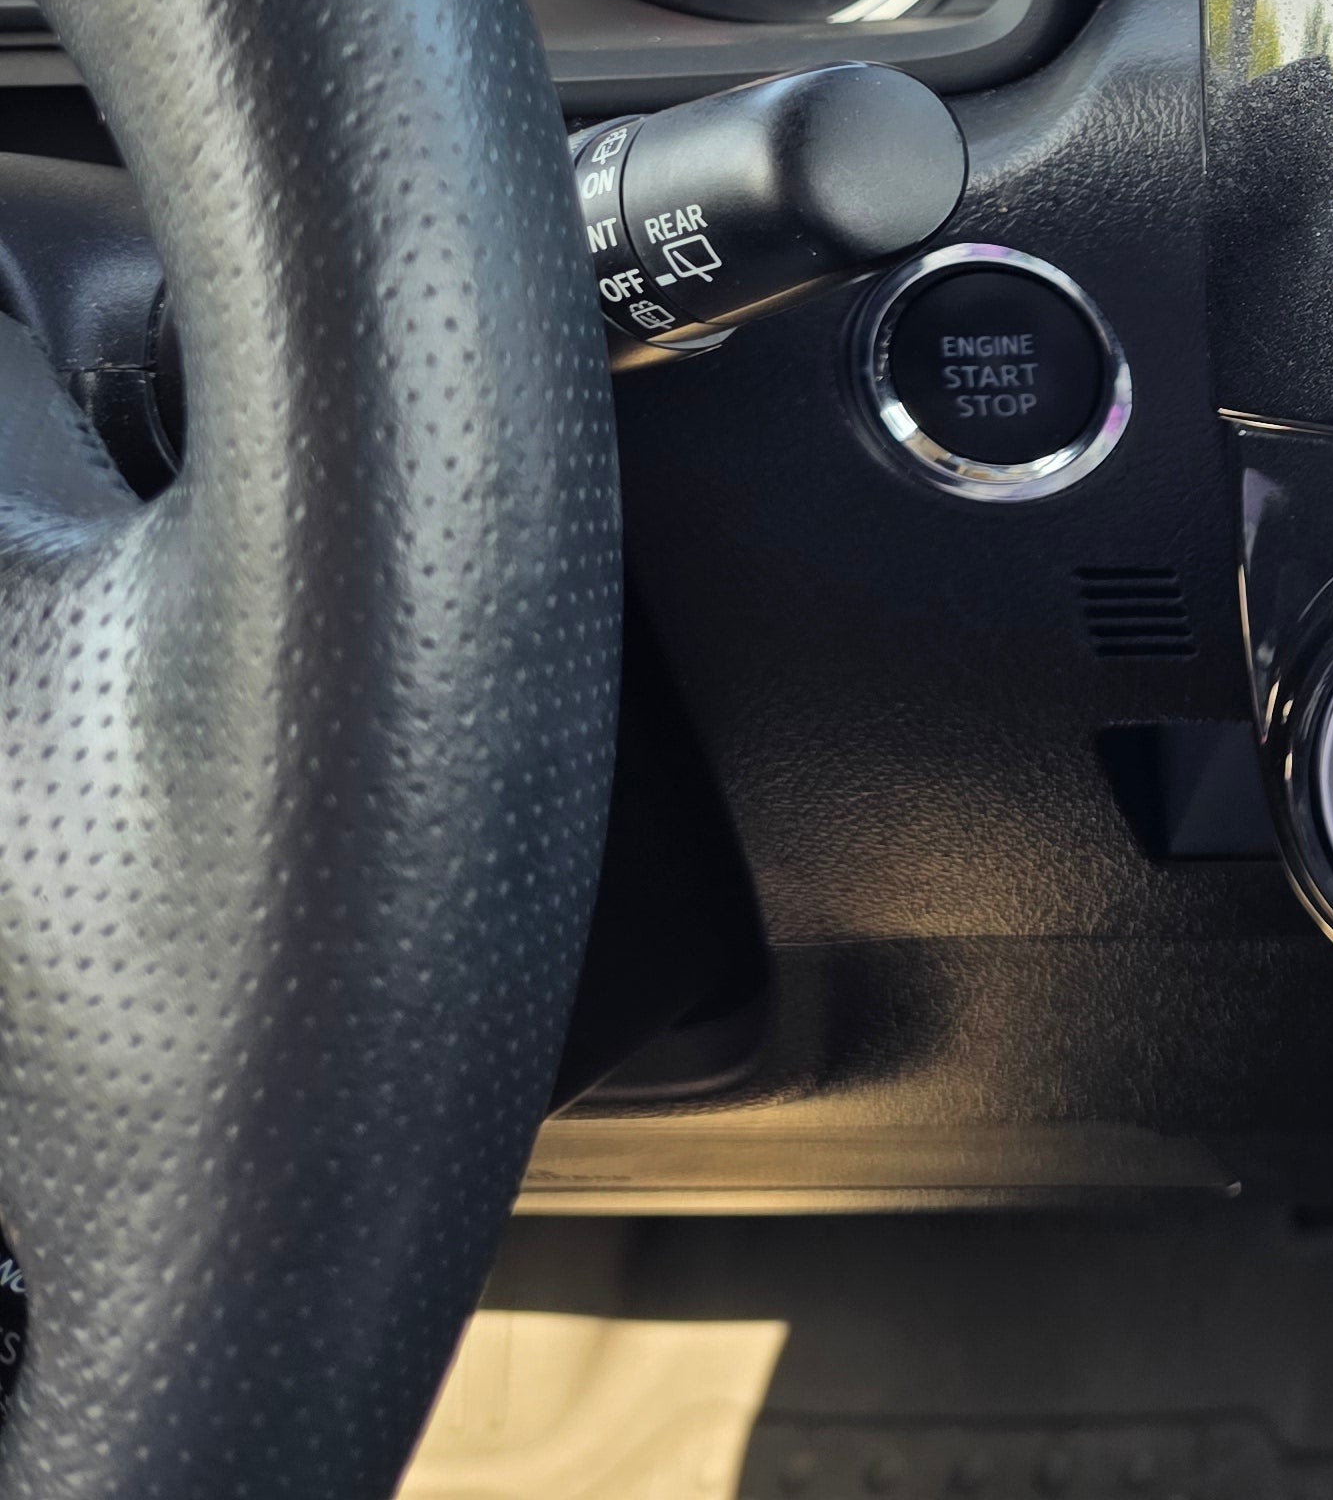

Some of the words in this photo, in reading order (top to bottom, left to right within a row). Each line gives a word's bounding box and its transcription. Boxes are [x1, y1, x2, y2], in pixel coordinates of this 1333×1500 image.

[582, 166, 615, 199] ON
[586, 217, 617, 253] NT
[644, 204, 708, 244] REAR
[600, 268, 643, 302] OFF
[943, 335, 1033, 357] ENGINE
[945, 364, 1038, 388] START
[957, 394, 1036, 417] STOP
